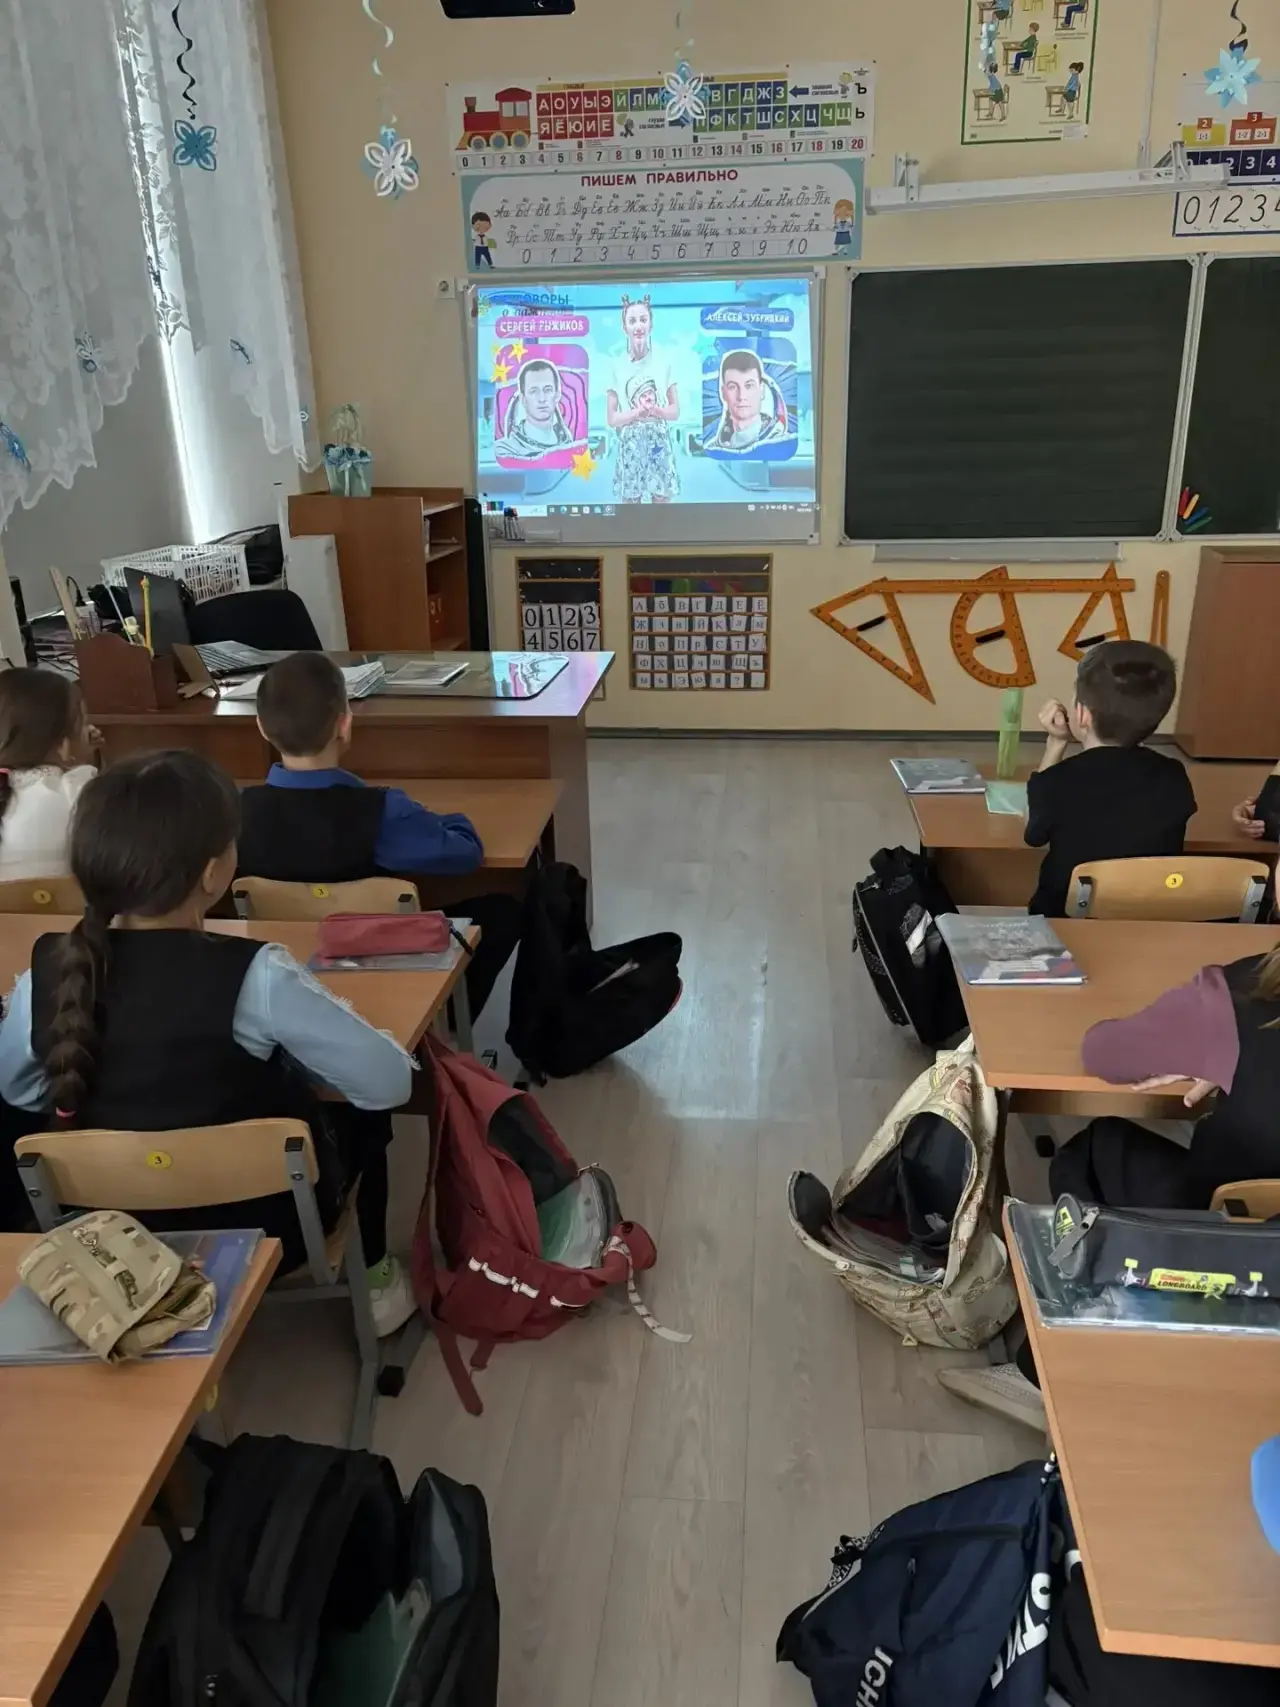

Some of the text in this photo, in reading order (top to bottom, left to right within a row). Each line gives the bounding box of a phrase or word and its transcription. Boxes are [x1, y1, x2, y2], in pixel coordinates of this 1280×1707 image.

[855, 83, 867, 95] Ъ
[539, 86, 784, 111] А О У Ы Э Й Л М В Г Д Ж З
[710, 114, 722, 126] Ф
[728, 113, 736, 125] К
[743, 112, 752, 124] Т
[757, 112, 770, 124] Ш
[775, 111, 784, 123] С
[791, 110, 800, 122] Х
[807, 109, 816, 123] Ц
[823, 108, 833, 120] Ч
[837, 107, 851, 122] Щ
[855, 107, 865, 119] Ь
[1251, 113, 1258, 122] 3
[540, 119, 611, 135] Я Ё Ю И Е
[1201, 119, 1209, 128] 2
[462, 138, 863, 167] 0 1 2 3 4 5 6 7 8 9 10 11 12 13 14 15 16 17 18 19 20
[1246, 156, 1256, 169] 3
[1266, 156, 1276, 168] 4
[581, 169, 738, 187] ПИШЕМ ПРАВИЛЬНО
[1183, 196, 1200, 224] 0
[1209, 195, 1220, 224] 1
[1223, 194, 1243, 223] 2
[1250, 194, 1267, 222] 3
[522, 238, 808, 264] 0 1 2 3 4 5 6 7 8 9 10
[500, 319, 584, 333] СЕРГЕЙ РЫЖИКОВ
[525, 605, 596, 627] 0 1 2 3
[527, 632, 597, 650] 4 5 6 7
[1157, 1281, 1208, 1291] LONGBOARD
